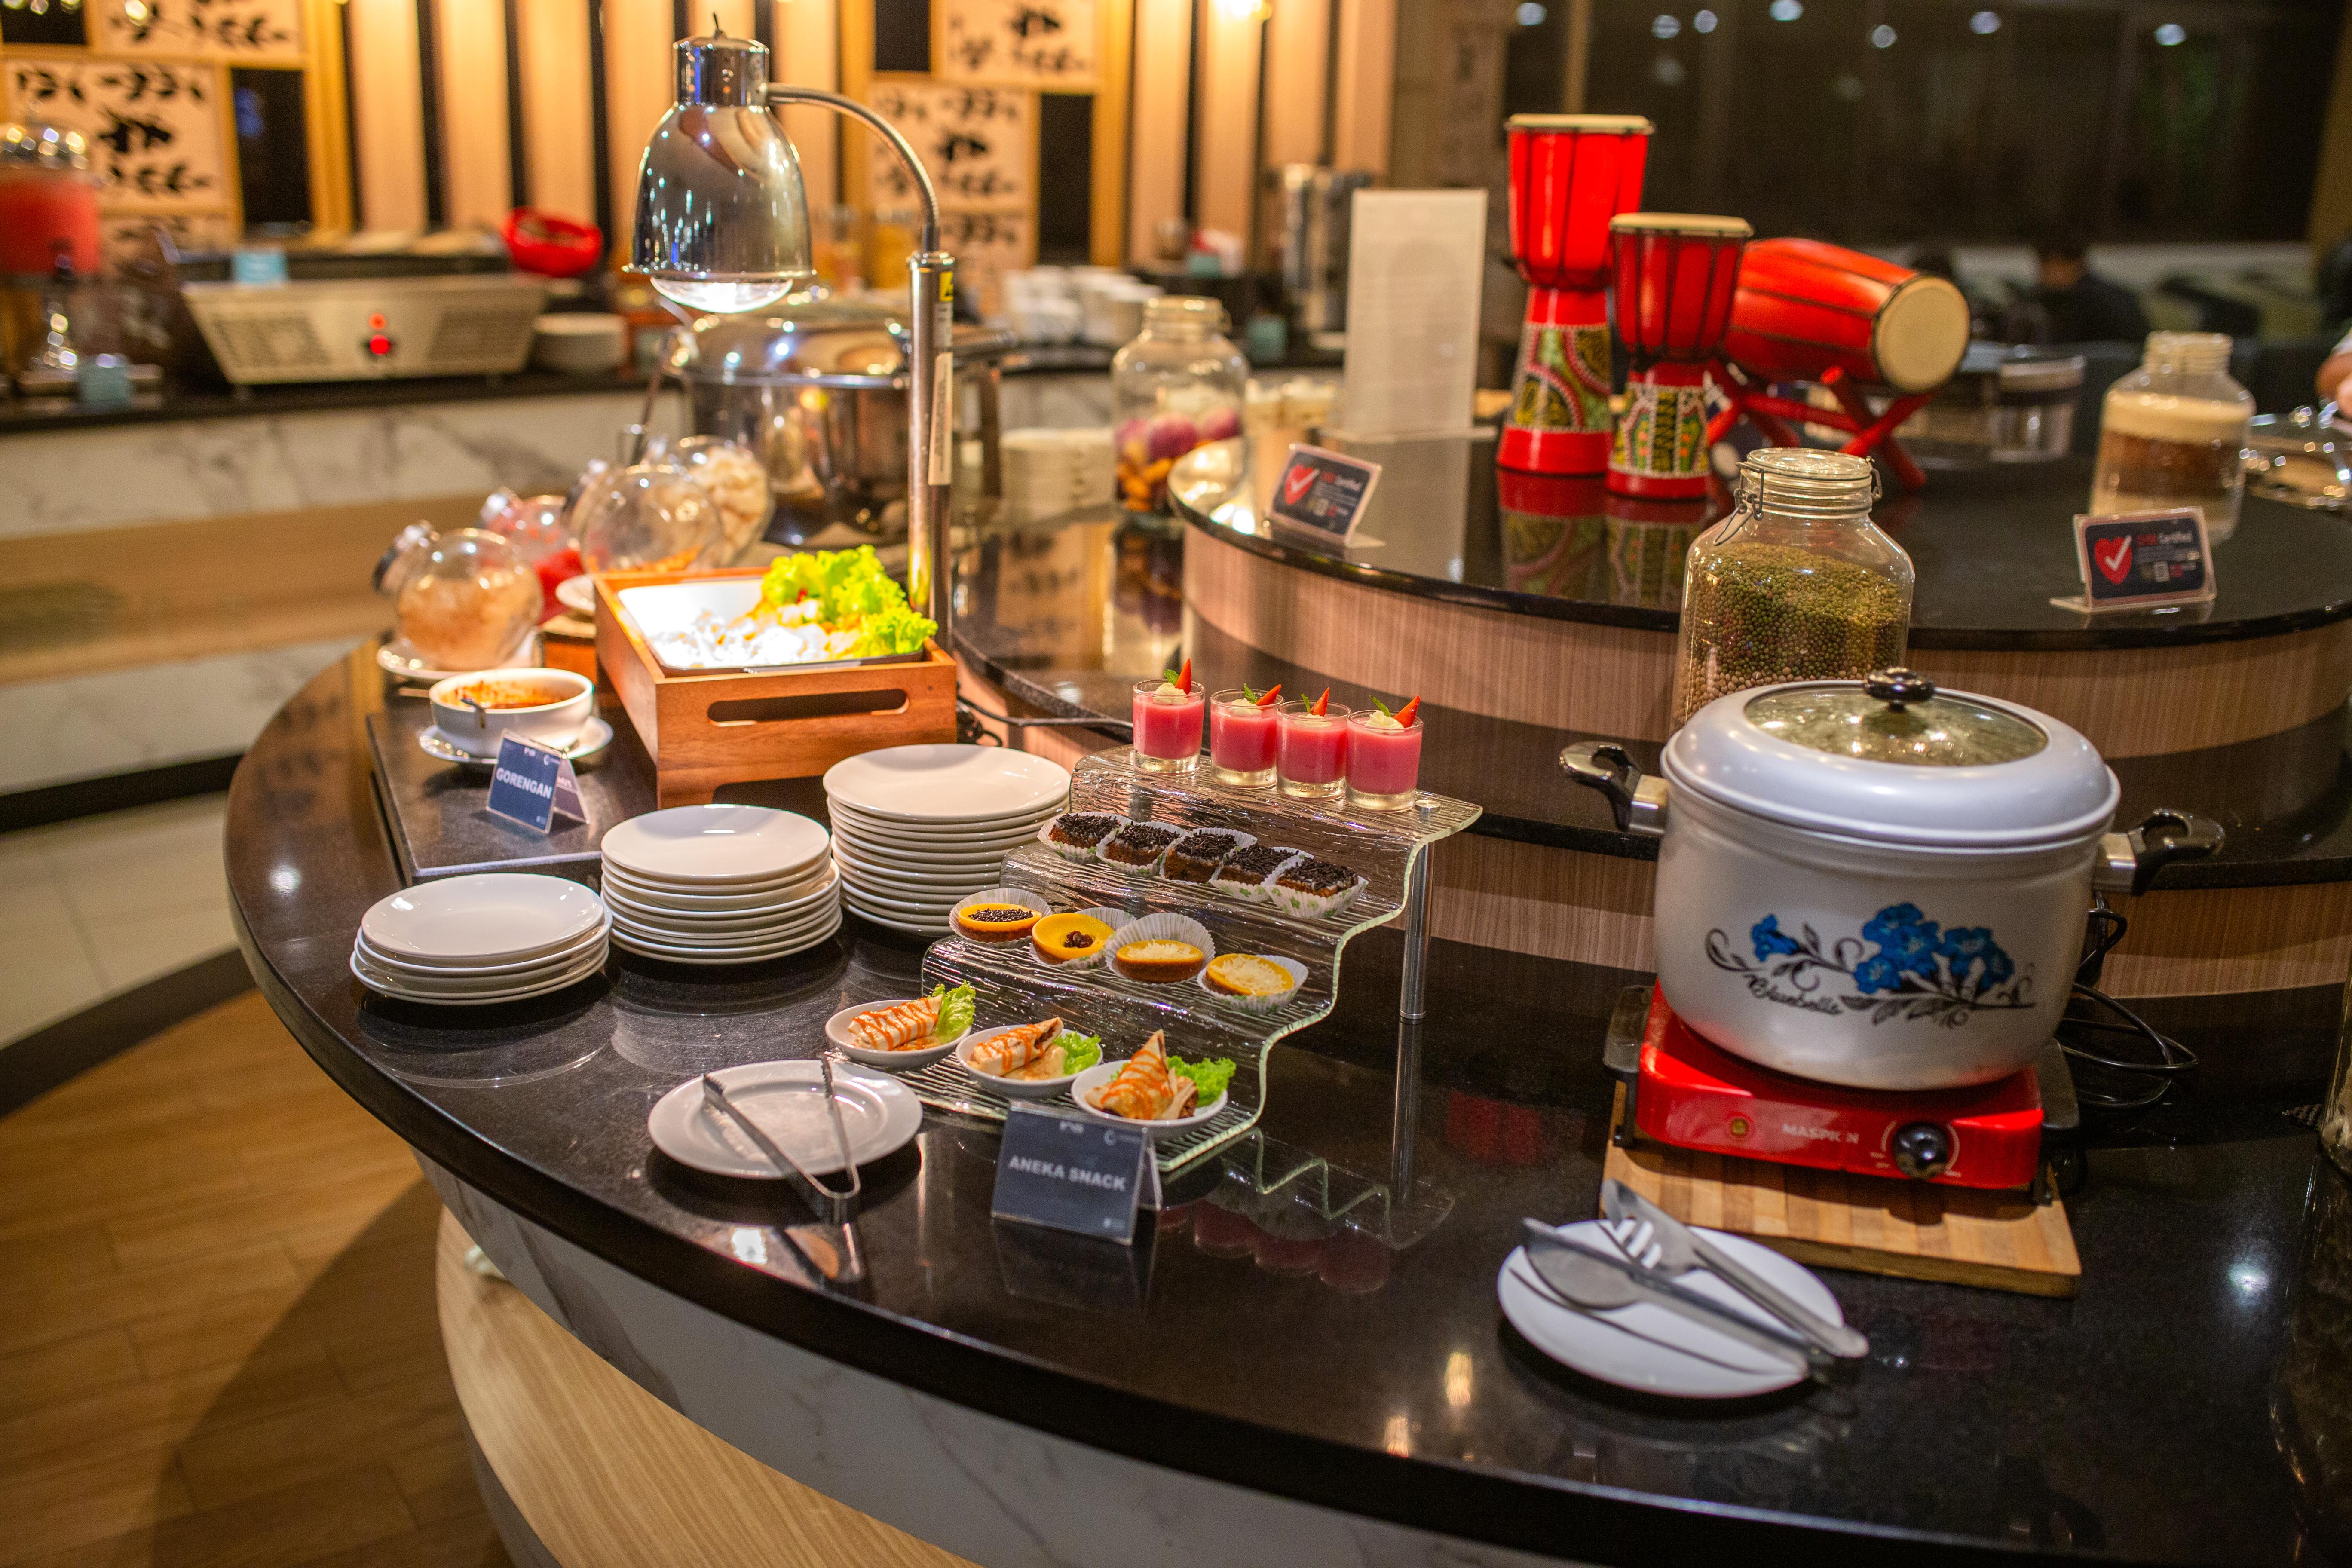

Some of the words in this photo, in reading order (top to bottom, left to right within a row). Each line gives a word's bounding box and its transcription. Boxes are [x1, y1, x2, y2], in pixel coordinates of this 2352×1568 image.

[496, 767, 552, 799] GORENGAN
[1782, 1124, 1860, 1145] MASPIN
[1008, 1155, 1065, 1179] ANEKA
[1068, 1166, 1126, 1191] SNACK
